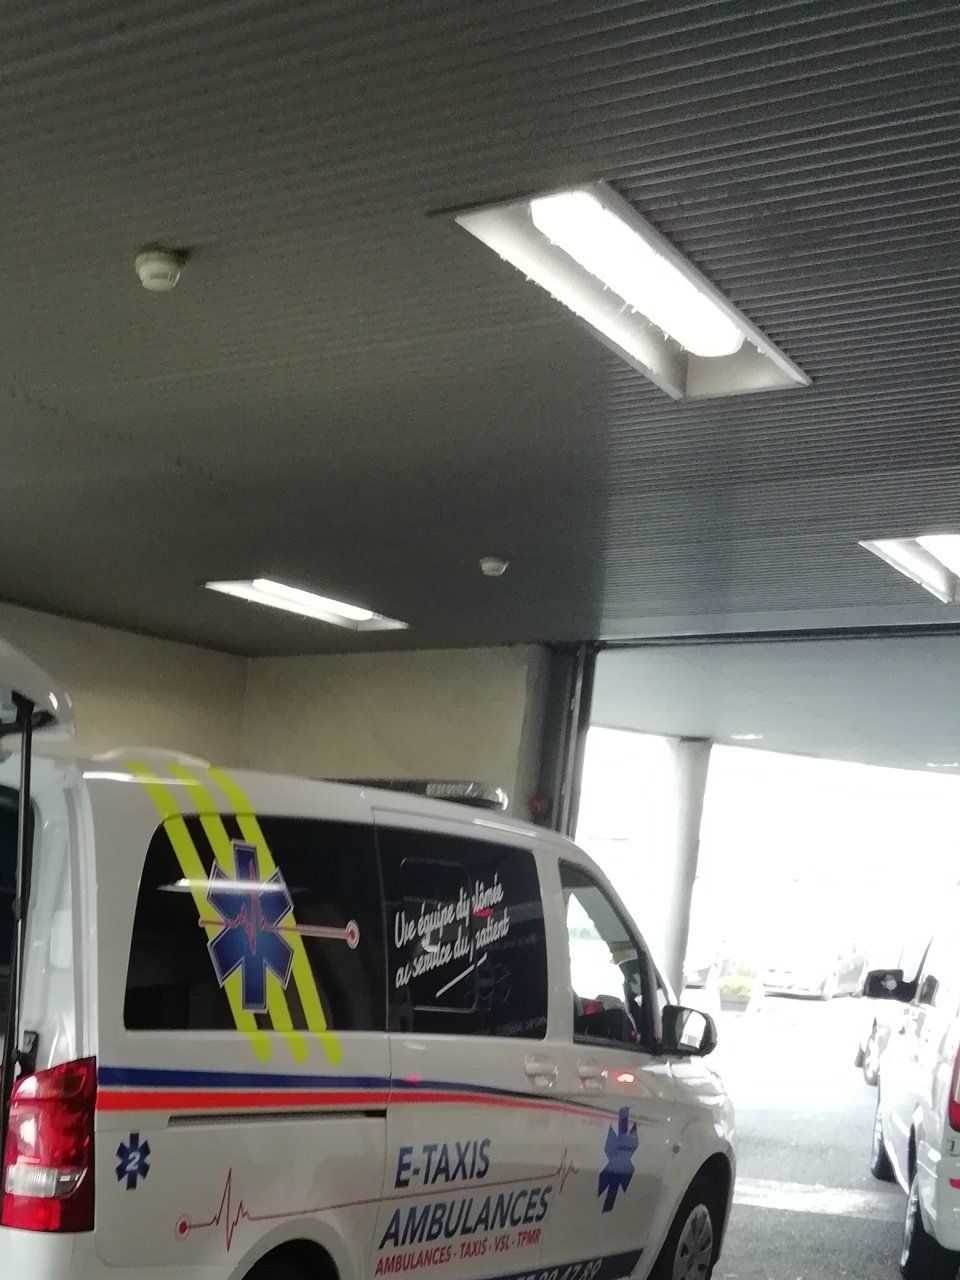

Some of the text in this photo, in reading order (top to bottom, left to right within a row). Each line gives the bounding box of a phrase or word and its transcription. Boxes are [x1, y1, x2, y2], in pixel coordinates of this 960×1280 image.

[454, 924, 470, 959] du
[125, 1150, 141, 1171] 2
[394, 1138, 491, 1189] E-TAXIS
[378, 1185, 552, 1250] AMBULANCES
[375, 1228, 541, 1276] AMBULANCES TAXIS VSL TPMR
